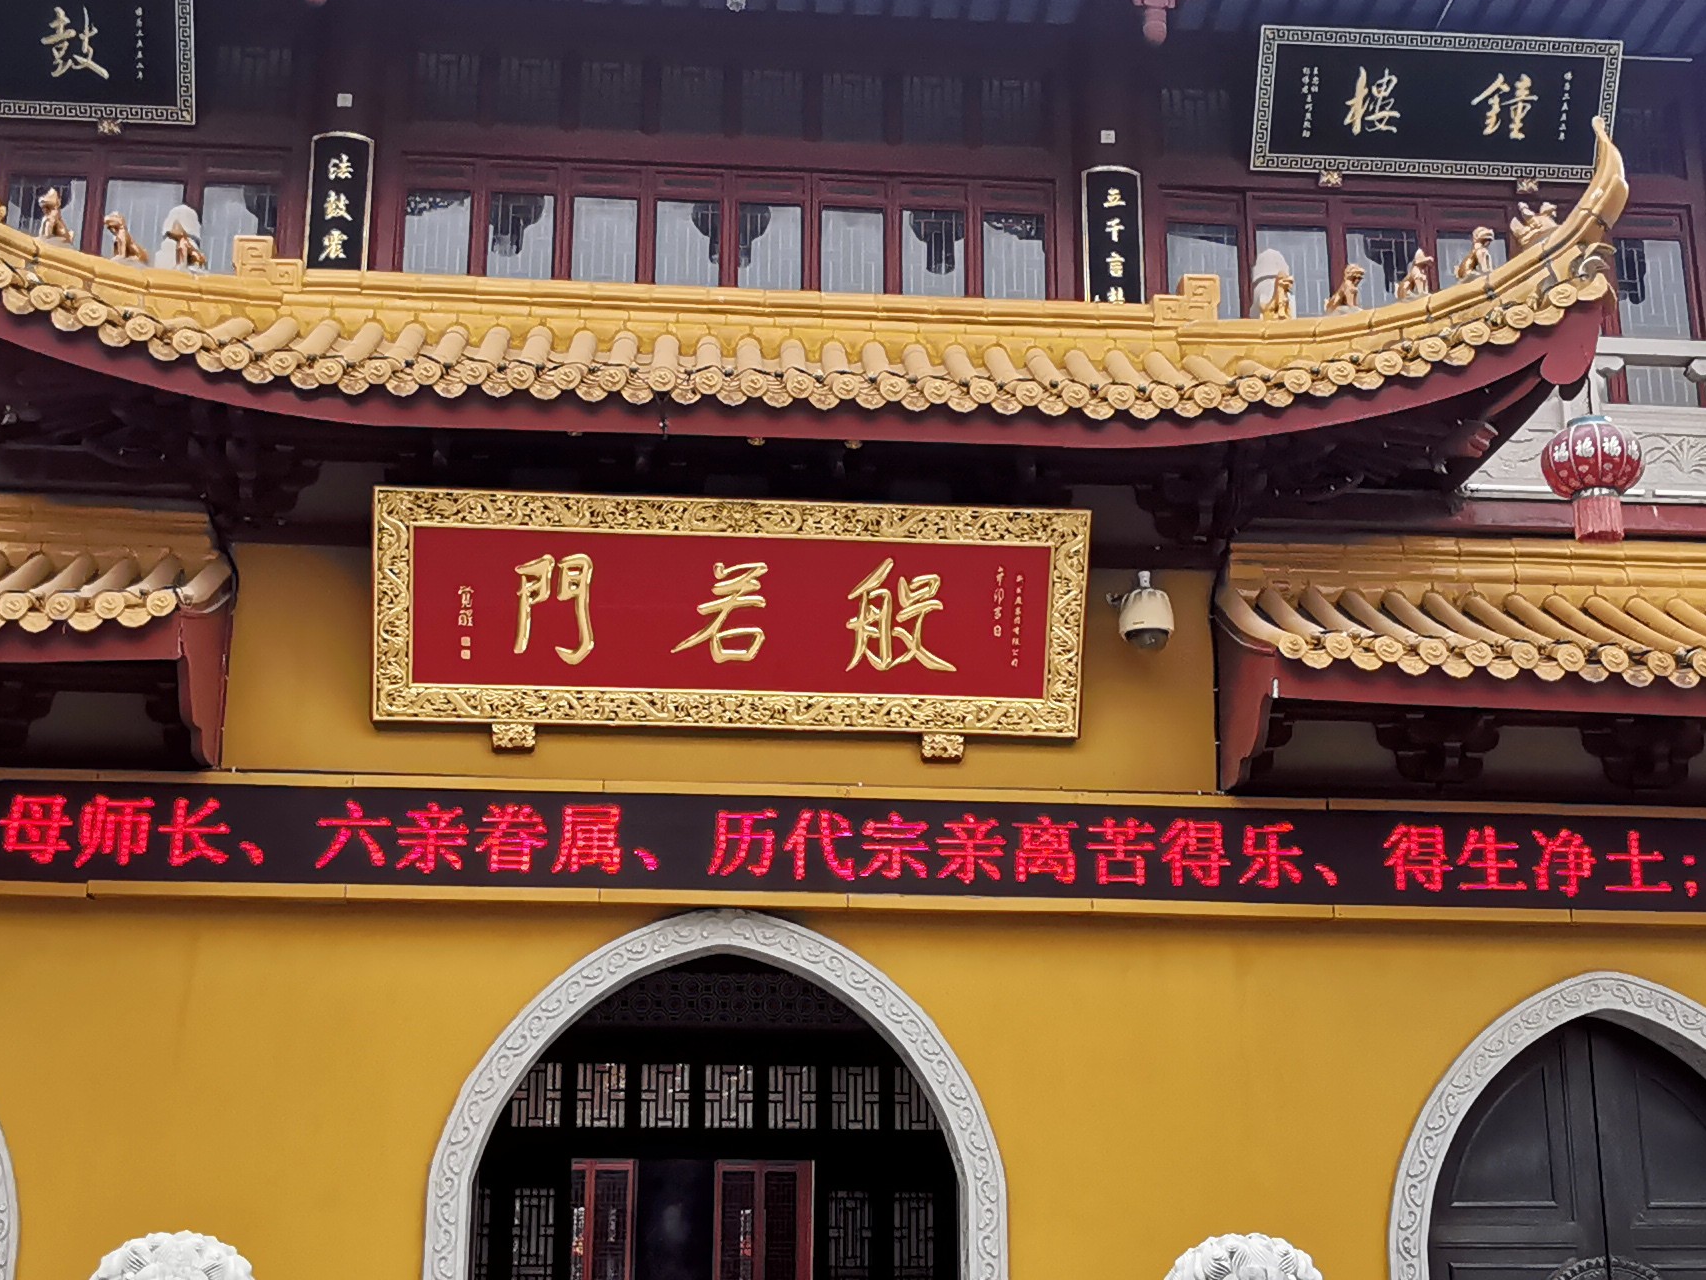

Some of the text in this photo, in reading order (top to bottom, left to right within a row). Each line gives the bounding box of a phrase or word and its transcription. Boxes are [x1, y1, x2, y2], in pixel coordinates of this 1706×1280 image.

[1553, 441, 1569, 463] 福
[1575, 436, 1595, 457] 福
[1602, 435, 1621, 457] 福
[514, 553, 957, 672] 般若門
